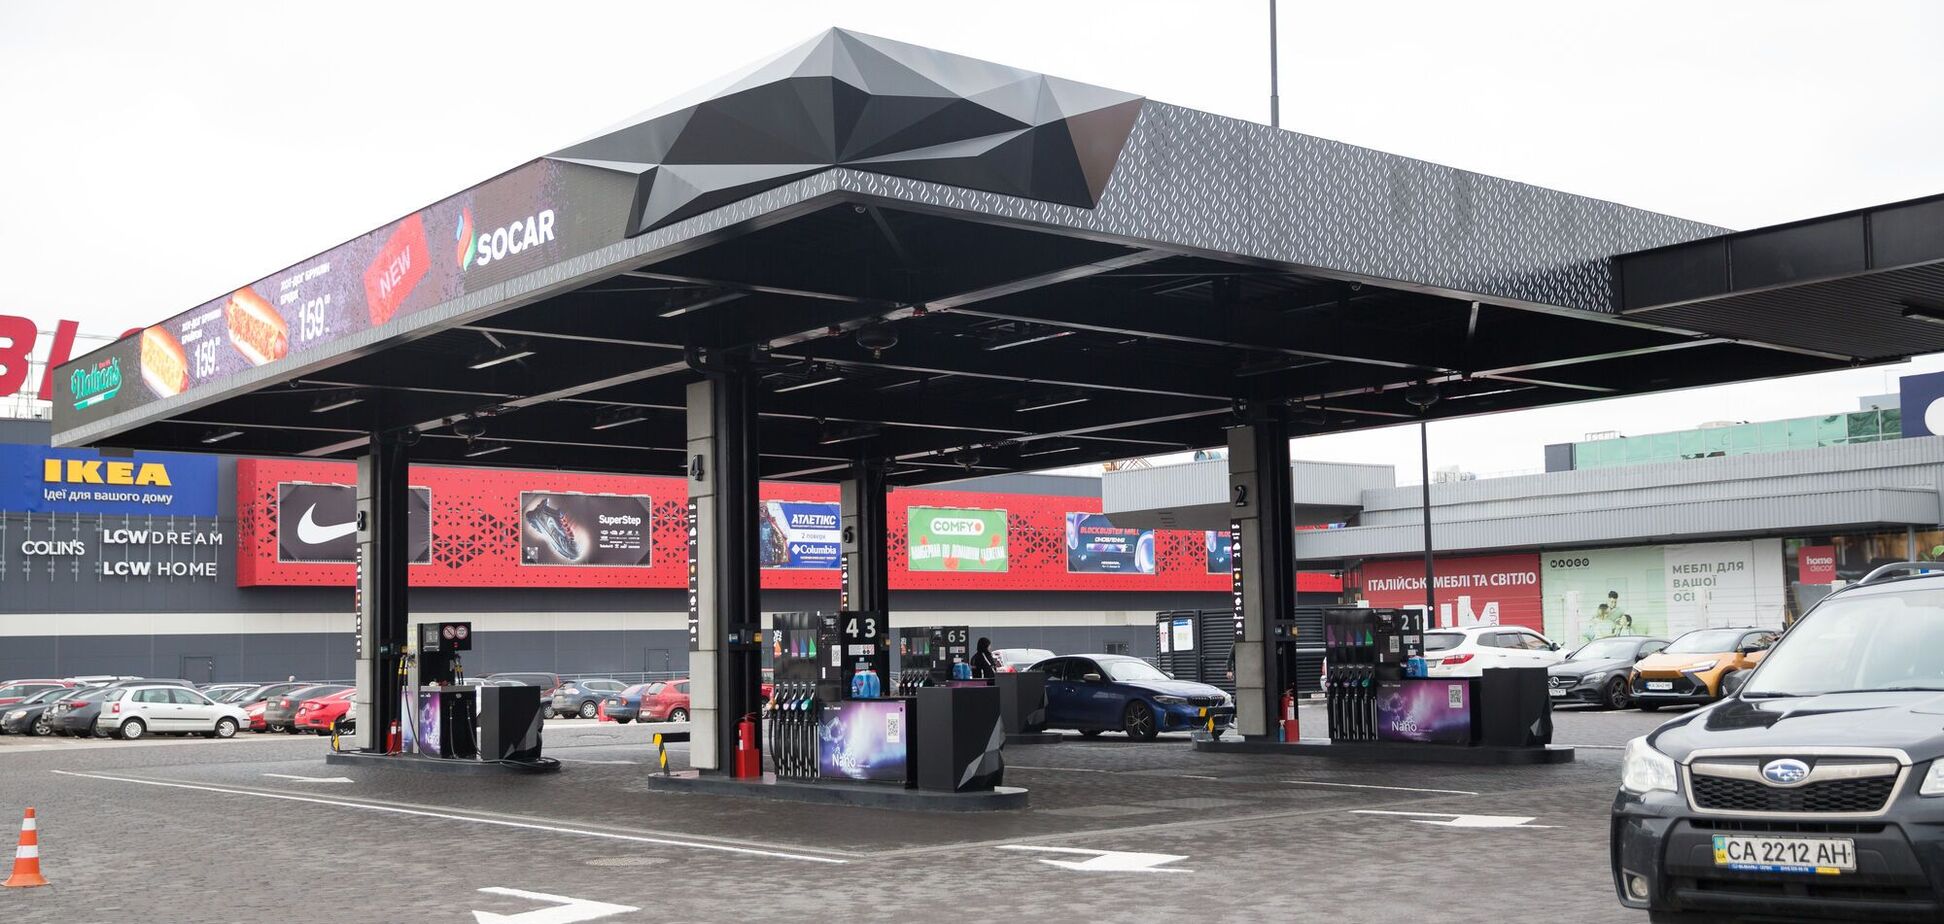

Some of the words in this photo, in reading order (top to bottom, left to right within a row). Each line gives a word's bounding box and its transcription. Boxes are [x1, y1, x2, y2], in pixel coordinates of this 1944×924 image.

[476, 209, 555, 266] SOCAR
[379, 245, 410, 297] NEW
[298, 296, 325, 342] 159
[194, 338, 216, 379] 159
[44, 459, 171, 486] IKEA
[690, 455, 704, 482] 4
[44, 488, 68, 501] Ідеї
[70, 491, 91, 501] для
[94, 492, 140, 503] вашого
[142, 493, 172, 505] дому
[1235, 485, 1249, 507] 2
[357, 510, 366, 531] 8
[599, 514, 641, 526] SuperStep
[933, 521, 974, 532] COMFY
[103, 530, 148, 544] LCW
[152, 531, 222, 545] DREAM
[22, 539, 85, 556] COLIN'S
[800, 544, 837, 555] Columbia
[103, 561, 150, 576] LCW
[157, 562, 216, 577] HOME
[1672, 563, 1712, 574] МЕБЛІ
[1717, 561, 1744, 573] ДЛЯ
[1806, 556, 1833, 565] home
[1368, 577, 1427, 592] ІТАЛІЙСЬК
[1433, 575, 1470, 588] МЕБЛІ
[1473, 574, 1488, 587] ТА
[1490, 572, 1536, 586] СВІТЛО
[1673, 575, 1717, 588] ВАШОЇ
[845, 618, 859, 638] 4
[864, 618, 876, 638] 3
[1401, 614, 1409, 630] 2
[1413, 614, 1420, 630] 1
[948, 630, 956, 643] 6
[959, 630, 966, 643] 5
[1391, 720, 1417, 732] Nano
[832, 754, 856, 768] Nano
[1727, 841, 1757, 861] CA
[1761, 842, 1810, 863] 2212
[1817, 843, 1847, 864] AH
